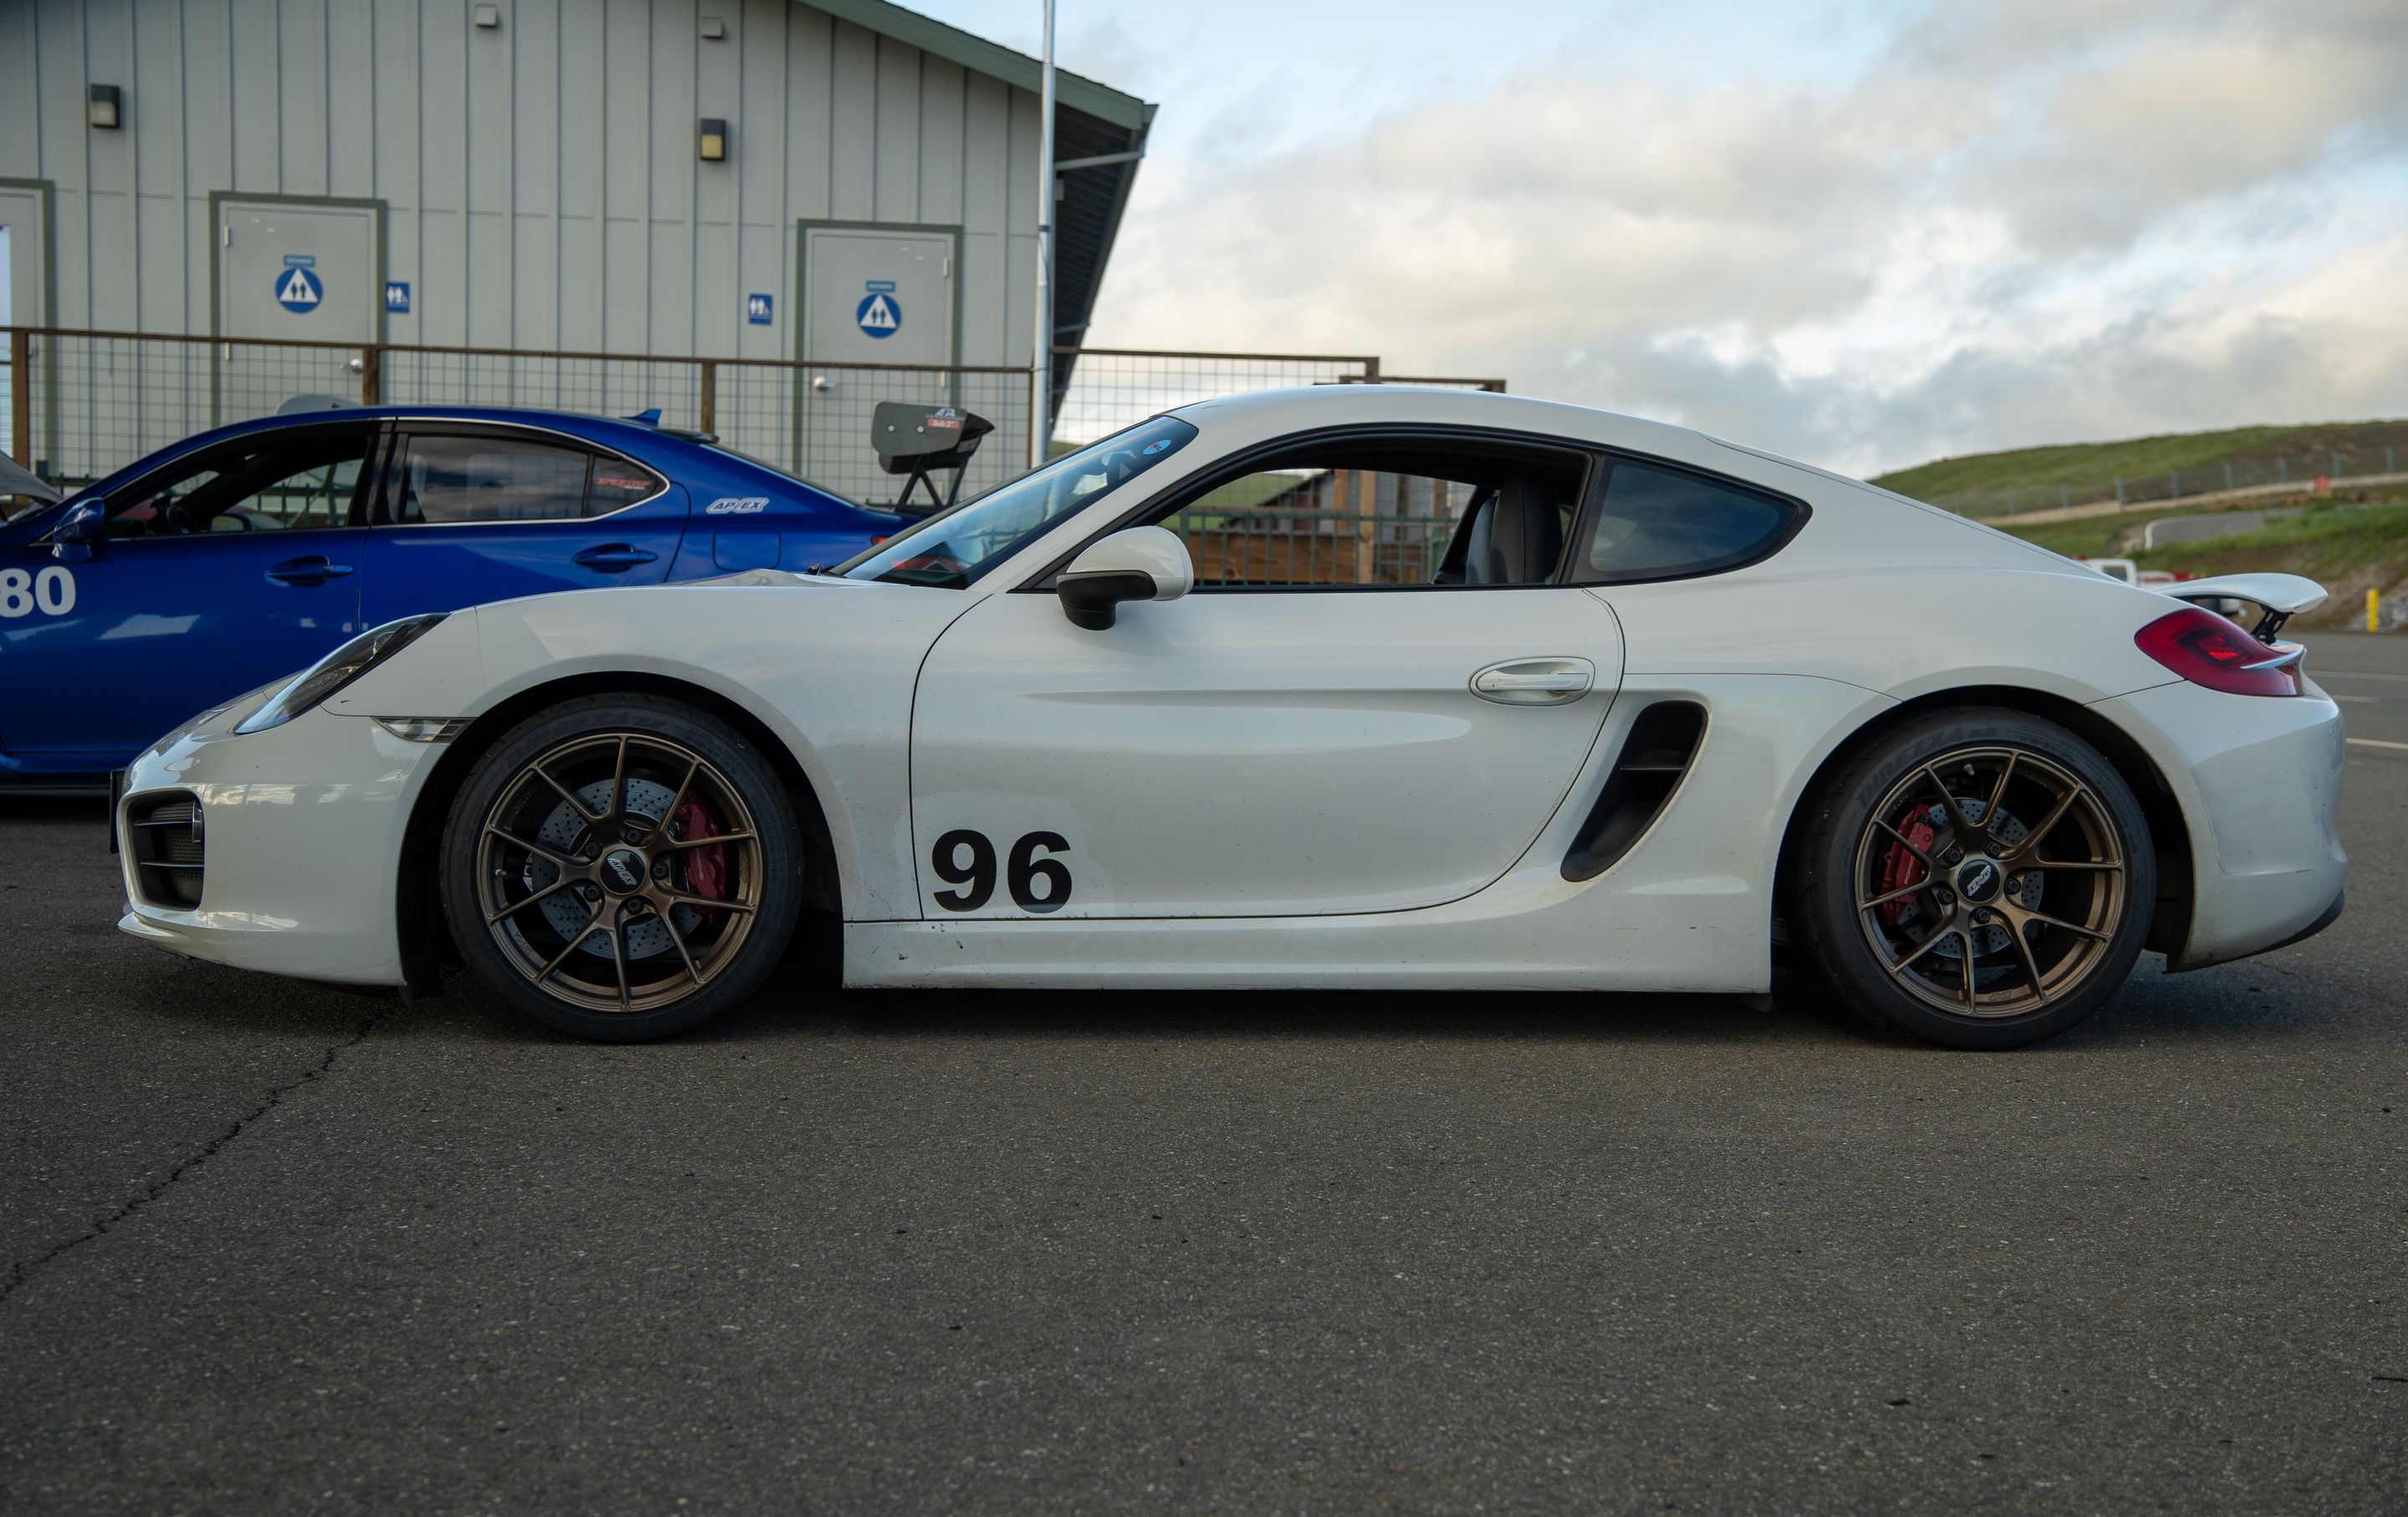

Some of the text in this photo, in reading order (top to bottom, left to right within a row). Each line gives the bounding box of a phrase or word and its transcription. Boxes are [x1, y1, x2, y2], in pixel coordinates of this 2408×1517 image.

[709, 498, 768, 513] APEX
[0, 566, 76, 618] 80
[608, 857, 638, 886] APEX
[931, 829, 1073, 914] 96
[1967, 865, 1992, 896] APEX
